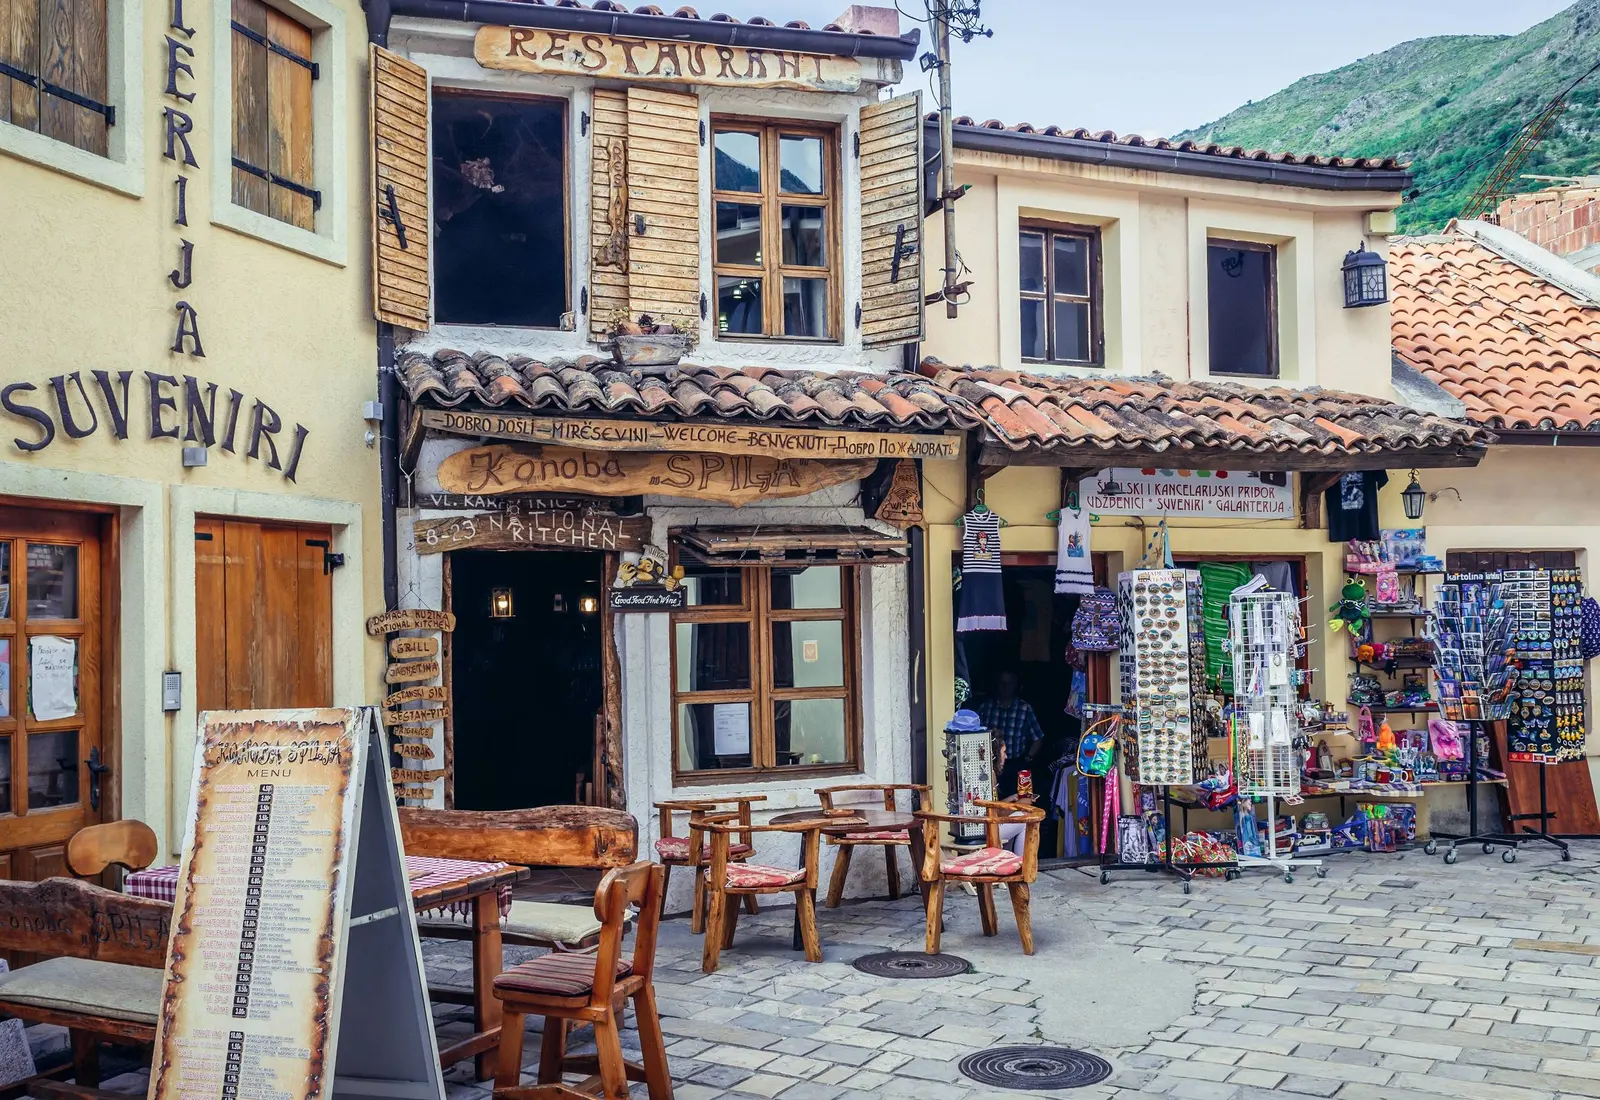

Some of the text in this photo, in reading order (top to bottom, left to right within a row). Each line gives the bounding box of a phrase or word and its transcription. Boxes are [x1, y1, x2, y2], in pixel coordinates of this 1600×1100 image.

[506, 28, 831, 83] RESTAURANT
[0, 370, 309, 484] SUVENIRI
[444, 413, 491, 433] DOBRO
[664, 426, 736, 444] WELCOME
[748, 431, 827, 451] BENVENUTI
[467, 451, 627, 492] Konoba
[1154, 484, 1235, 498] KANCELARIJSKI
[1237, 486, 1276, 499] PRIBOR
[1086, 494, 1284, 513] UDŽBENICI SUVENIRI GALANTERIJA
[426, 519, 477, 546] 8-23
[1446, 572, 1484, 581] kartolina
[414, 620, 450, 630] KITCHEN
[397, 642, 430, 653] GRILL
[247, 769, 292, 778] MENU
